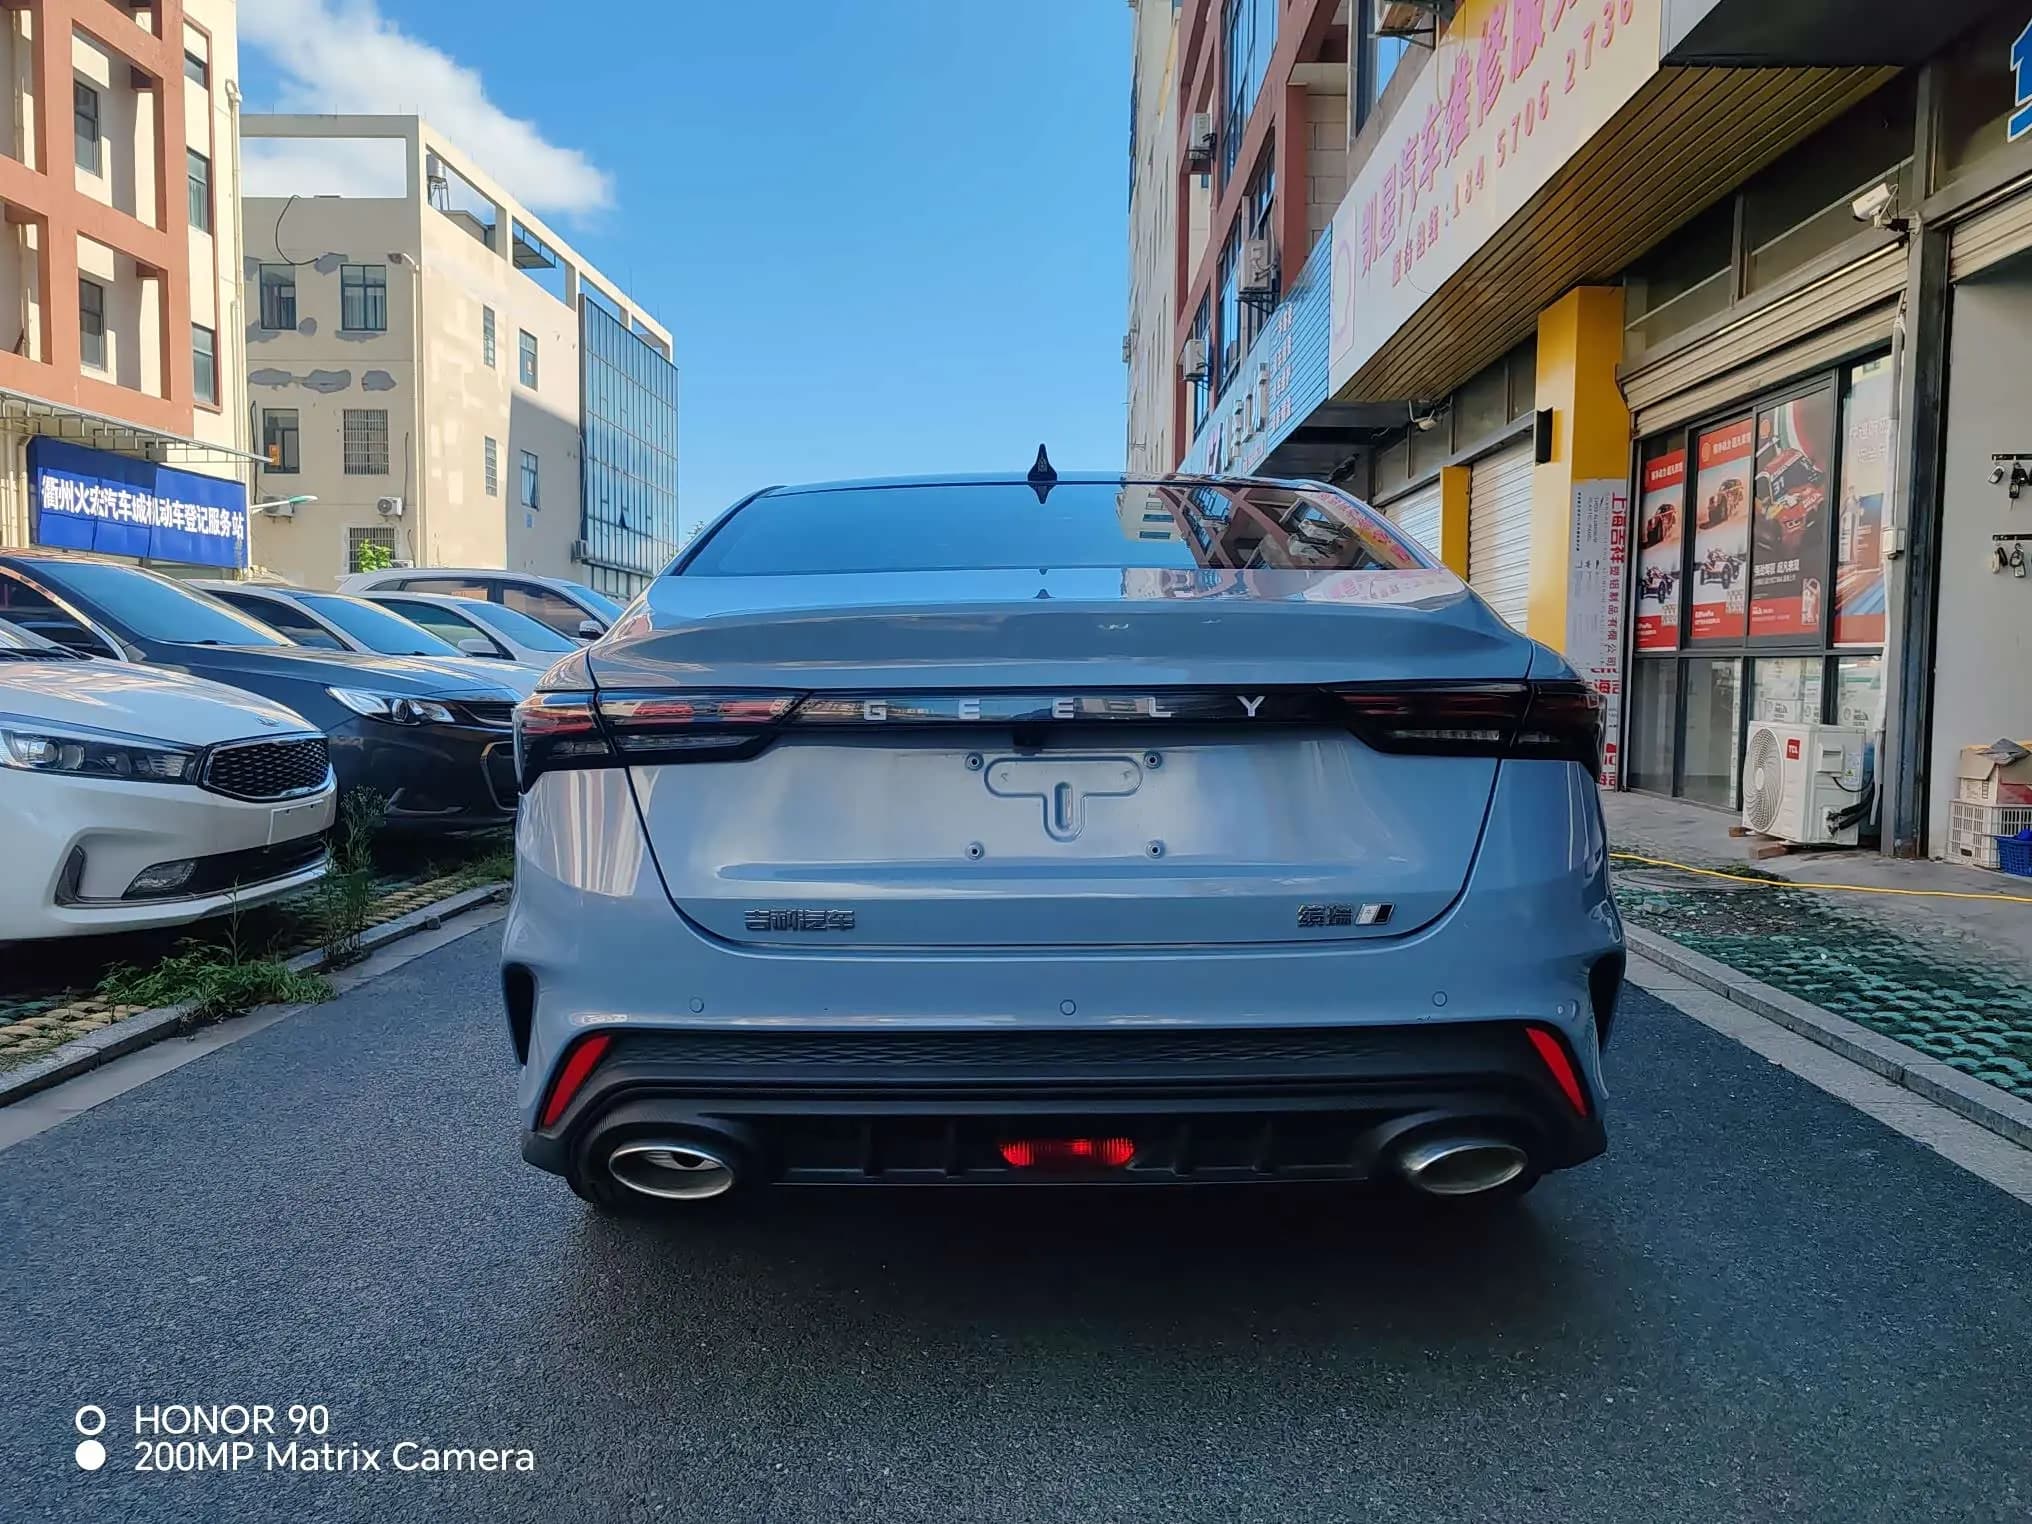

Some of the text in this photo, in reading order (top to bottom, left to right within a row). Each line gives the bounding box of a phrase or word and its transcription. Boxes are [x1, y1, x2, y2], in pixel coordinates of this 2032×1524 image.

[1361, 0, 1580, 279] 凯星汽车维修服
[1497, 79, 1551, 168] 5706
[864, 695, 1266, 722] GEELY
[744, 908, 856, 931] 吉利汽车
